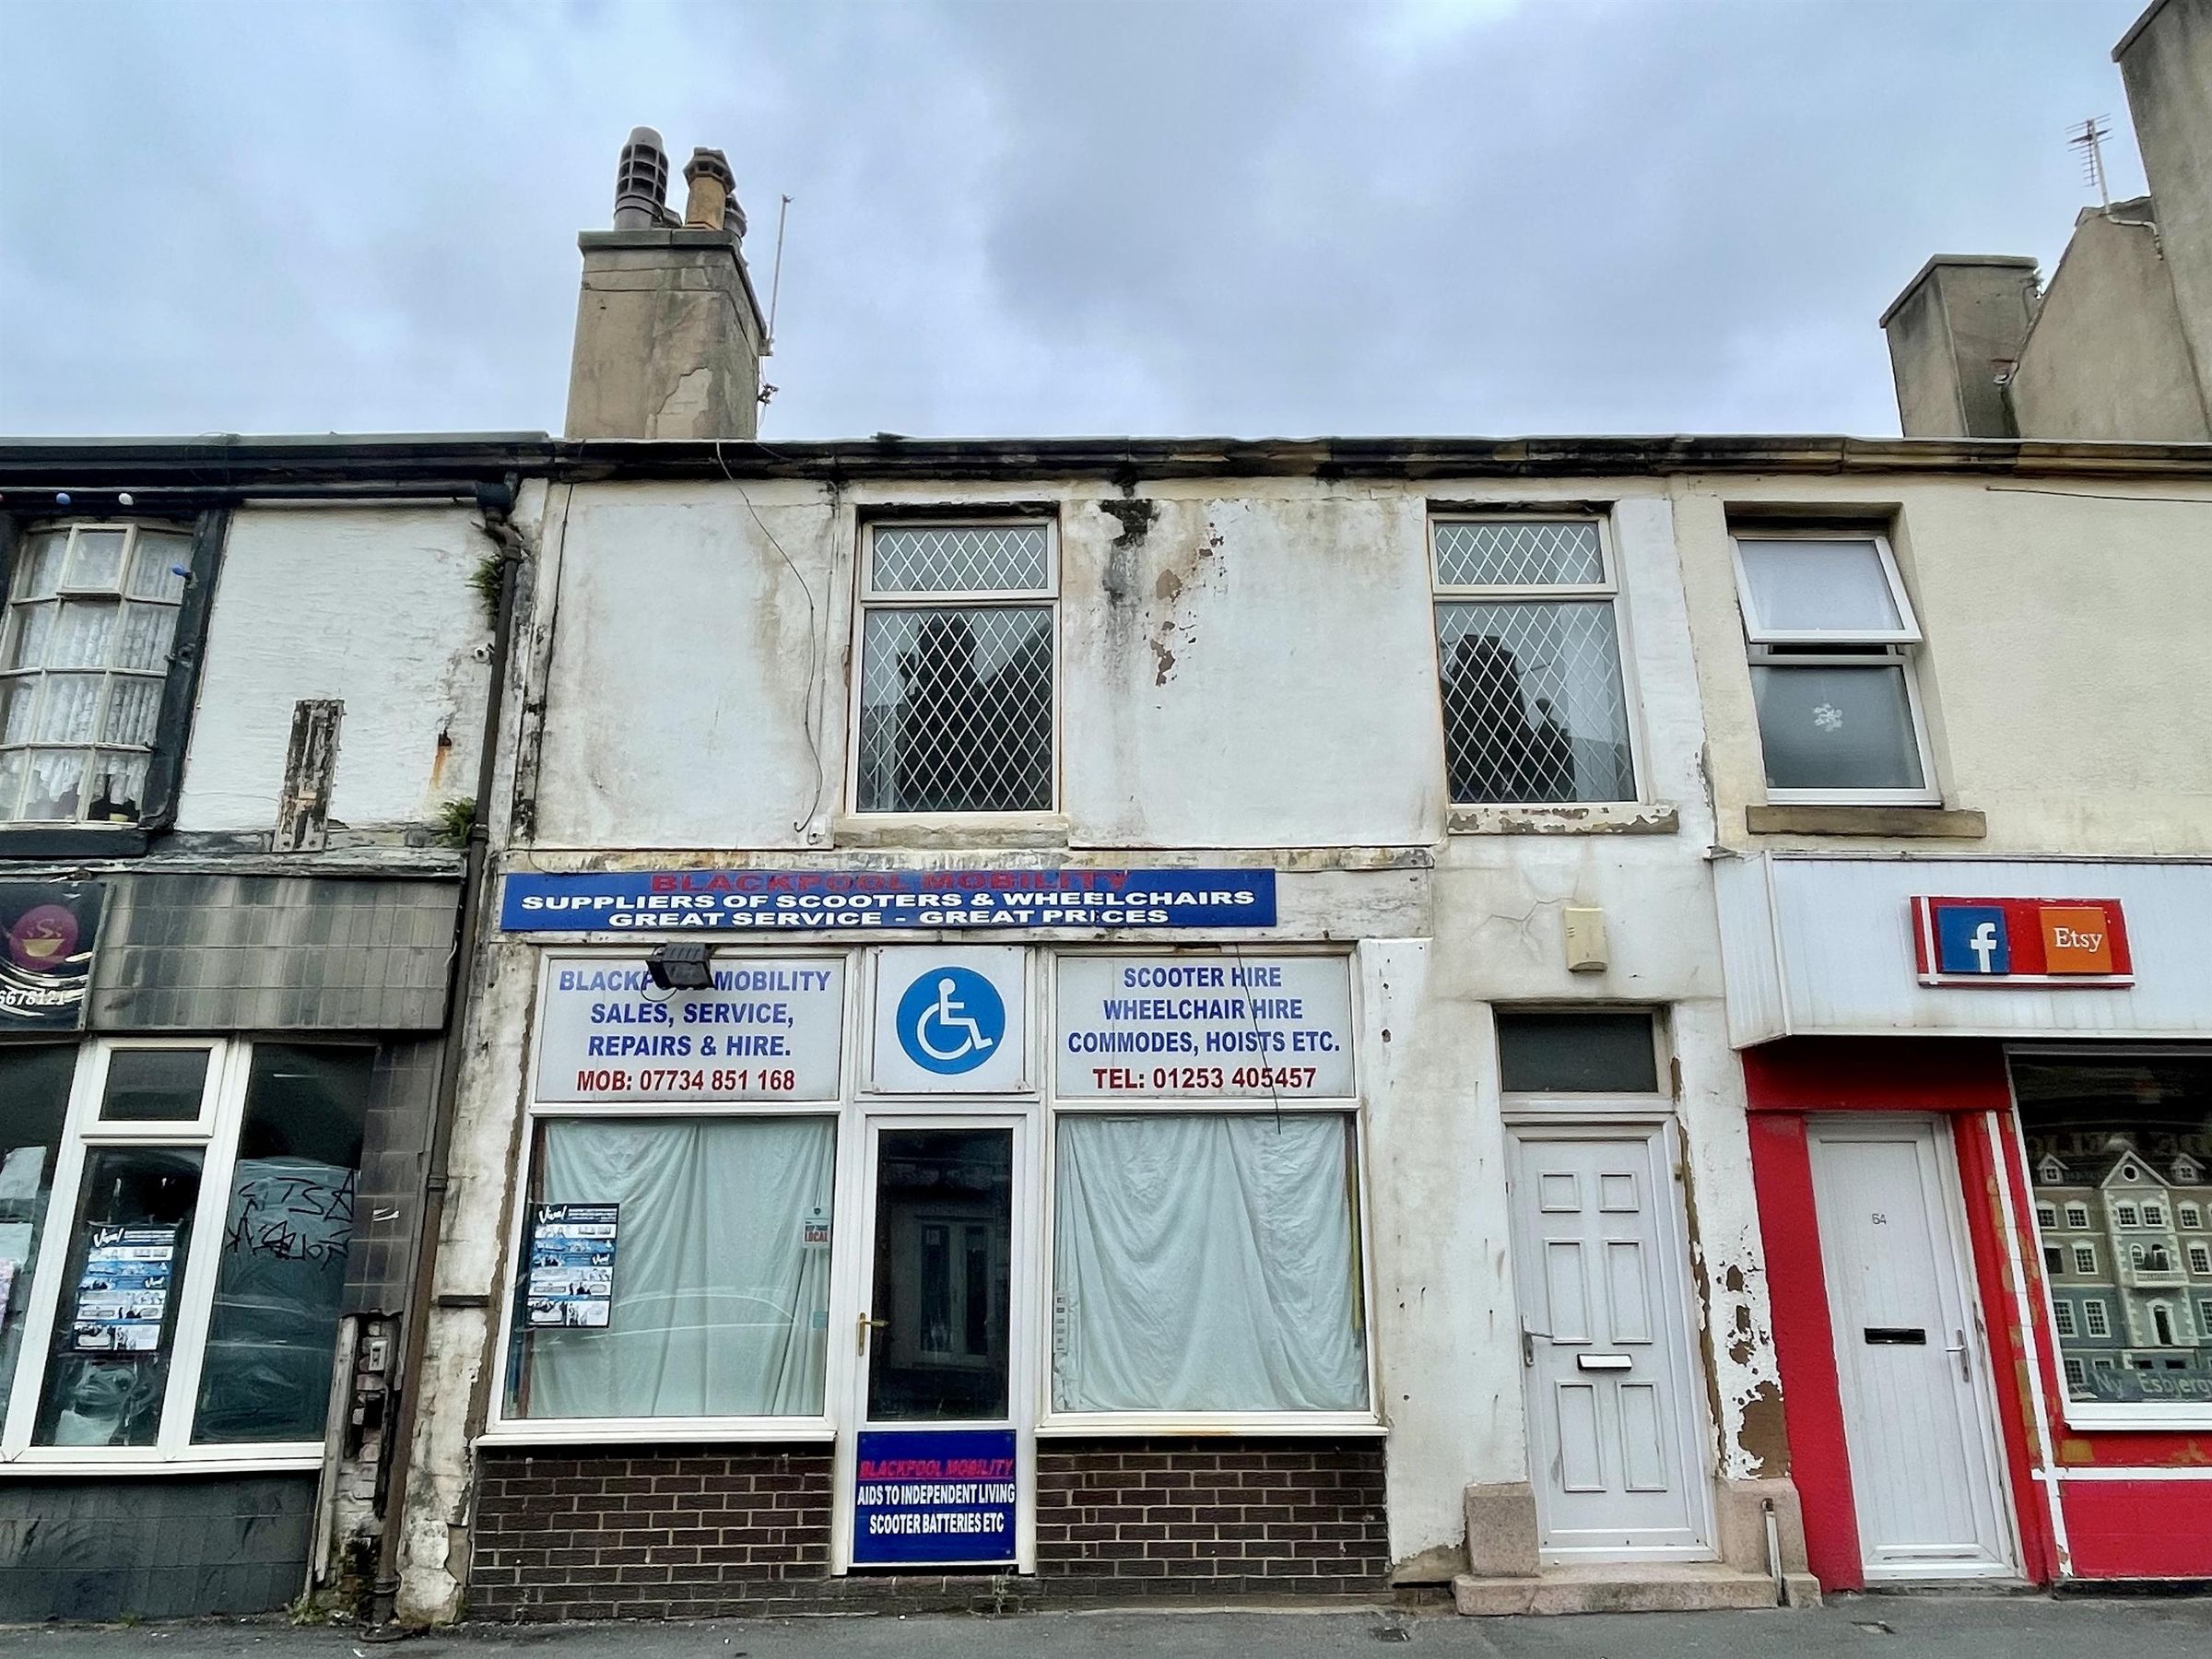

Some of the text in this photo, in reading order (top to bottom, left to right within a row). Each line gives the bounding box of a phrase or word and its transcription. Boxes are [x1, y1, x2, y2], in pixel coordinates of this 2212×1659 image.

[652, 870, 1130, 892] BLACKPOOL MOBILITY
[521, 891, 1255, 910] SUPPLIERS OF SCOOTERS & WHEELCHAIRS
[608, 912, 724, 927] GREAT
[732, 912, 882, 926] SERVICE
[919, 910, 1034, 924] GREAT
[1042, 910, 1169, 923] PRICES
[2053, 927, 2102, 953] Etsy
[559, 971, 831, 992] BLACKP MOBILITY
[1124, 968, 1282, 987] SCOOTER HIRE
[591, 1003, 794, 1028] SALES, SERVICE,
[1103, 999, 1303, 1019] WHEELCHAIR HIRE
[588, 1035, 791, 1057] REPAIRS & HIRE.
[1067, 1031, 1340, 1056] COMMODES, HOISTS ETC.
[577, 1069, 795, 1091] MOB: 07734 851 168
[1093, 1067, 1317, 1089] TEL: 01253 405457
[2137, 1371, 2212, 1399] Esbjerg
[860, 1458, 1014, 1477] BLACKPOOL MOBILITY
[857, 1483, 1016, 1505] AIDS TO INDEPENDENT LIVING
[869, 1512, 1005, 1535] SCOOTER BATTERIES ETC
